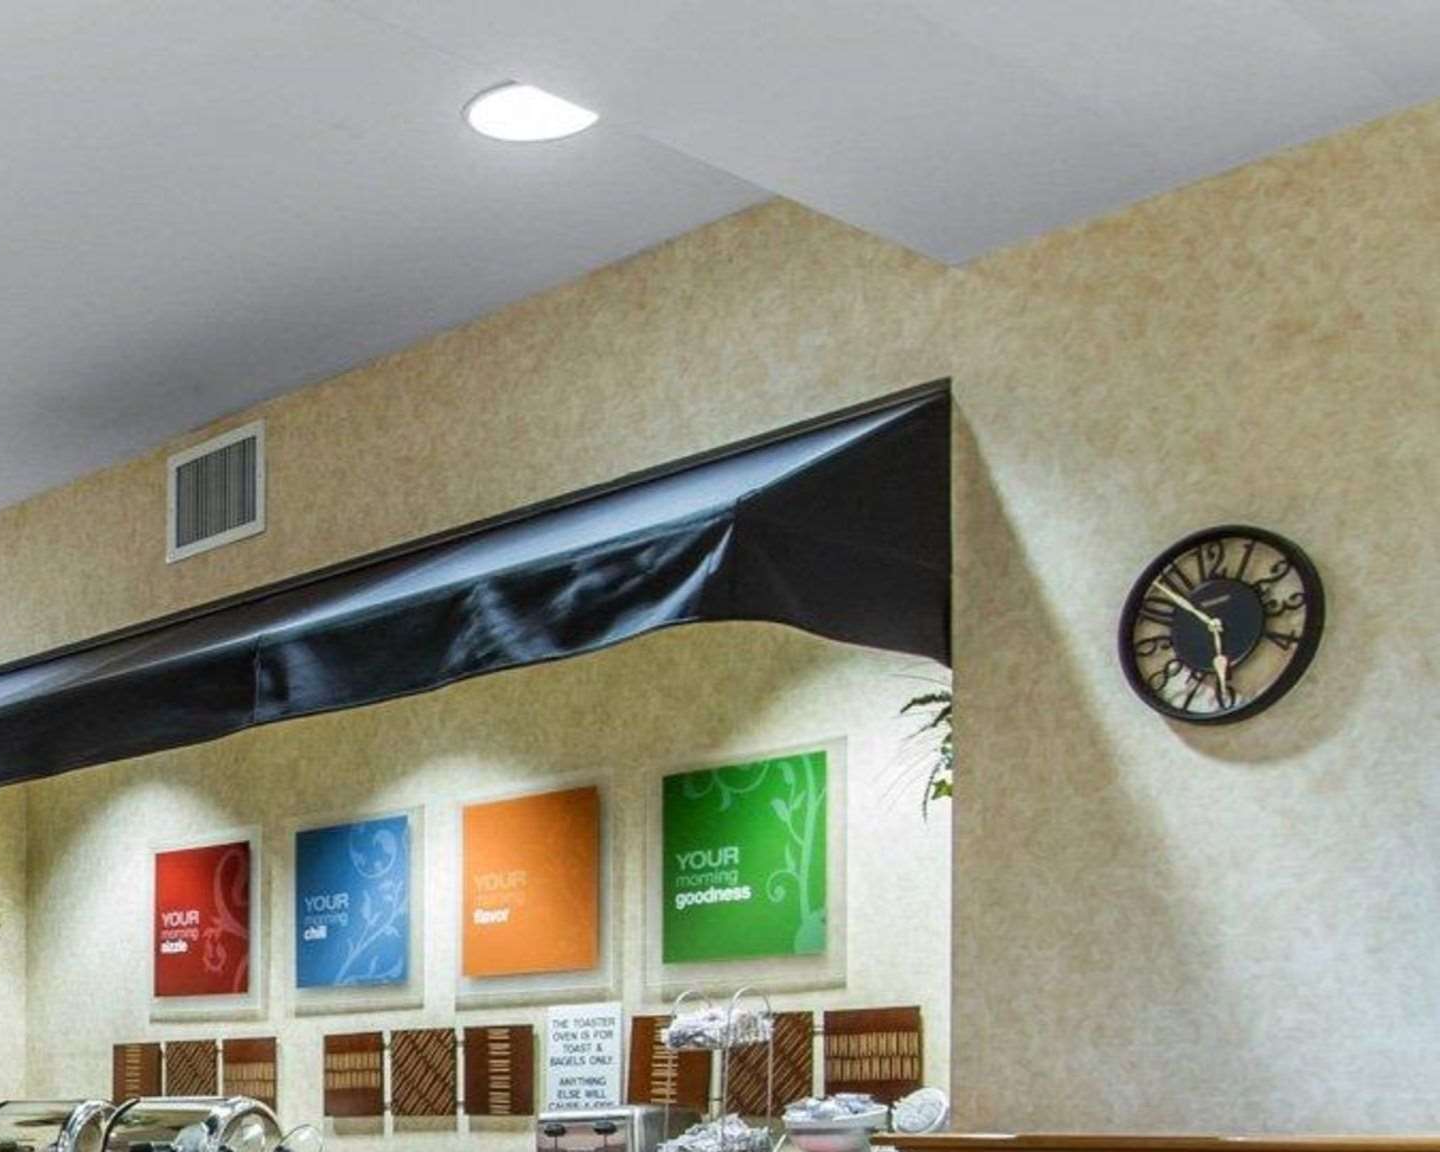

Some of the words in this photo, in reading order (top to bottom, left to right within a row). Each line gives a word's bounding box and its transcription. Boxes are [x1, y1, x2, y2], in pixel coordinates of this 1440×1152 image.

[675, 846, 739, 871] YOUR
[675, 870, 739, 888] morning
[304, 892, 349, 913] YOUR
[675, 885, 752, 910] goodness
[161, 910, 200, 928] YOUR
[552, 1019, 569, 1029] THE
[573, 1017, 616, 1028] TOASTER
[552, 1030, 578, 1042] OVEN
[580, 1030, 590, 1040] IS
[593, 1029, 614, 1040] FOR
[563, 1043, 592, 1054] TOAST
[550, 1056, 586, 1067] BAGELS
[558, 1076, 607, 1086] ANYTHING
[556, 1089, 581, 1100] ELSE
[585, 1089, 607, 1099] WILL
